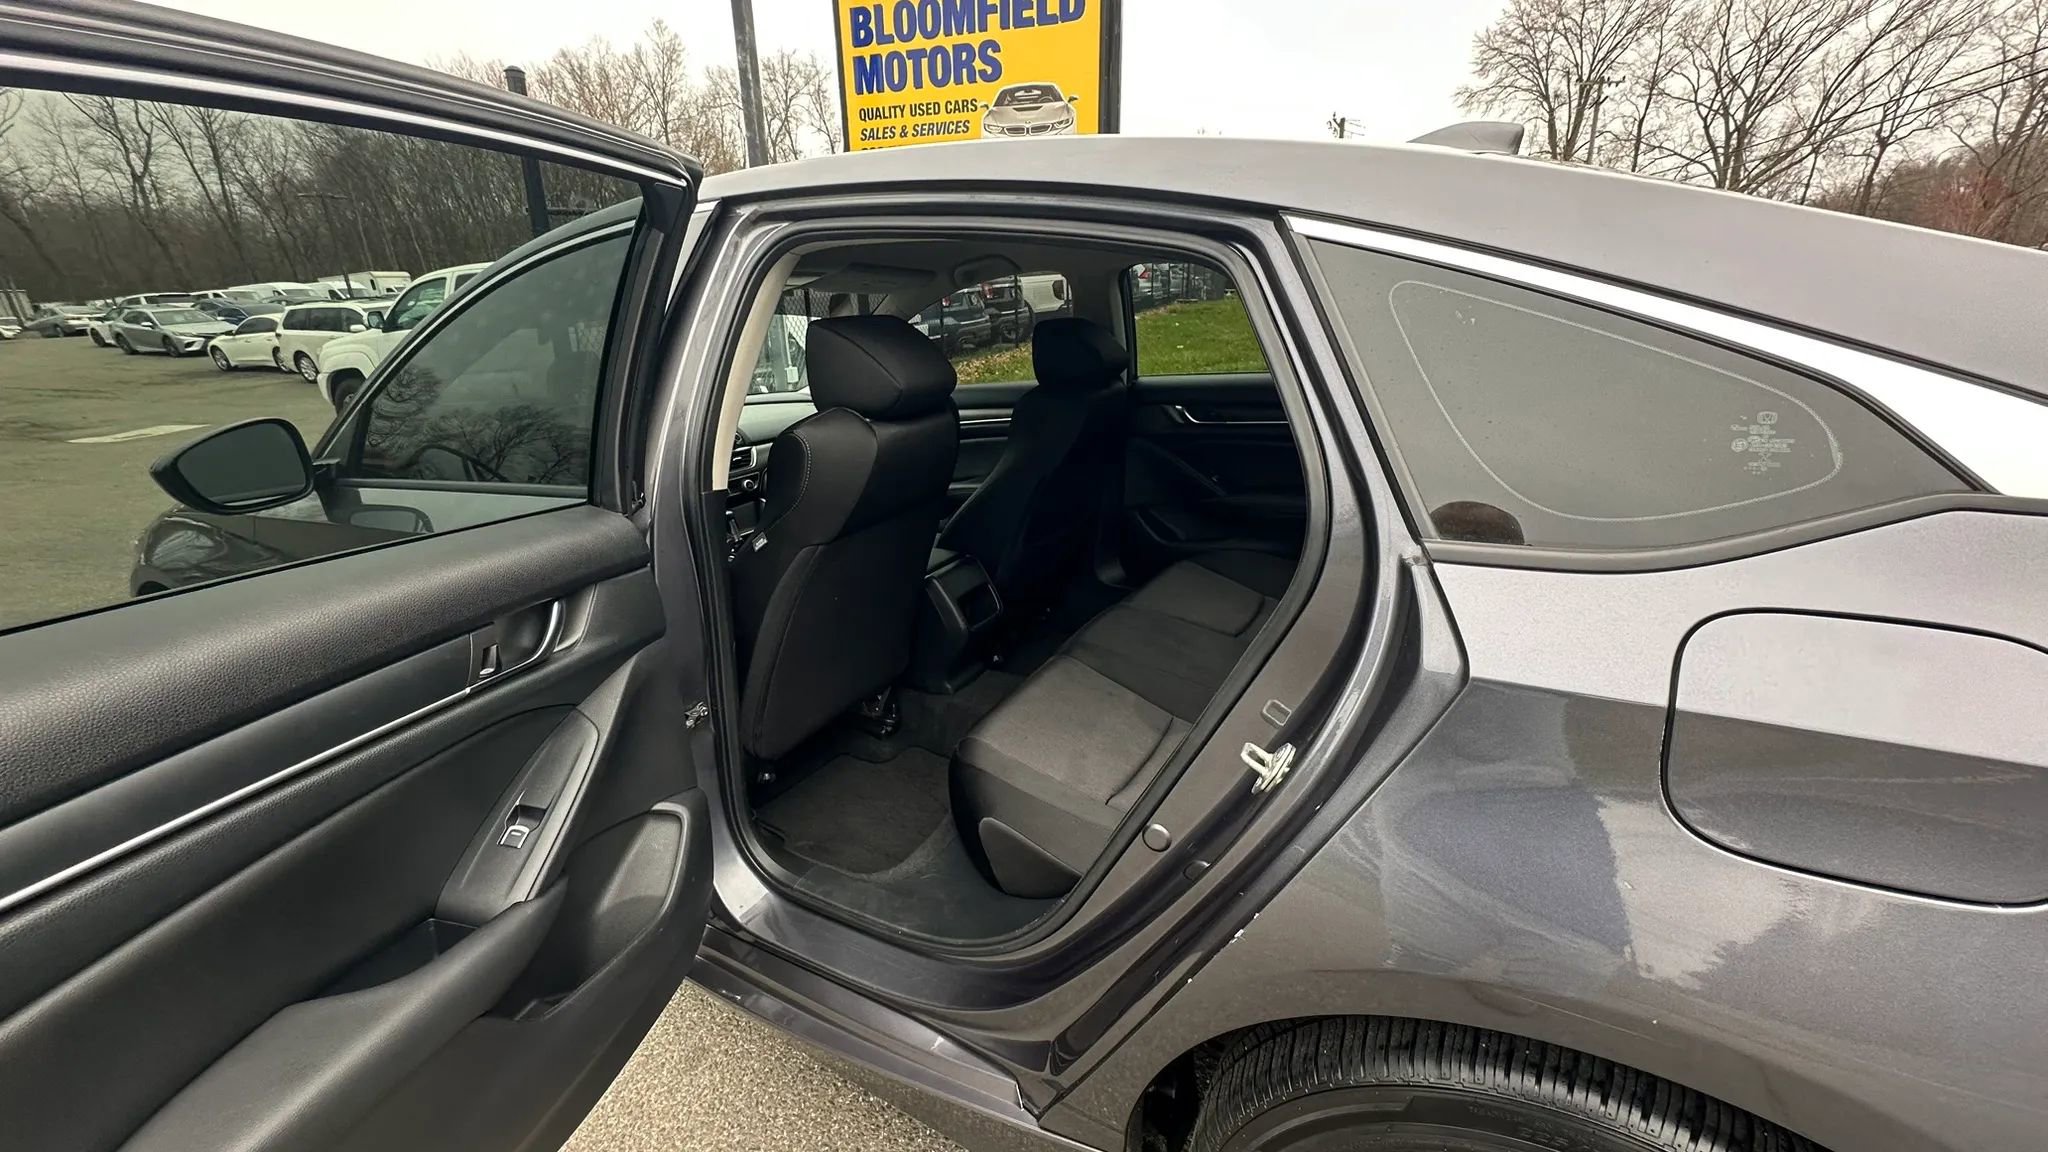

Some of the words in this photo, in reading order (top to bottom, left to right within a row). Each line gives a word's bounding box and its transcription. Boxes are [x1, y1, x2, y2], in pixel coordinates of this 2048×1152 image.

[849, 0, 1086, 48] BLOOMFIELD
[852, 39, 1003, 95] MOTORS
[859, 104, 905, 122] QUALITY
[909, 101, 940, 117] USED
[945, 98, 978, 114] CARS
[860, 126, 896, 141] SALES
[899, 124, 909, 138] &
[911, 120, 971, 137] SERVICES
